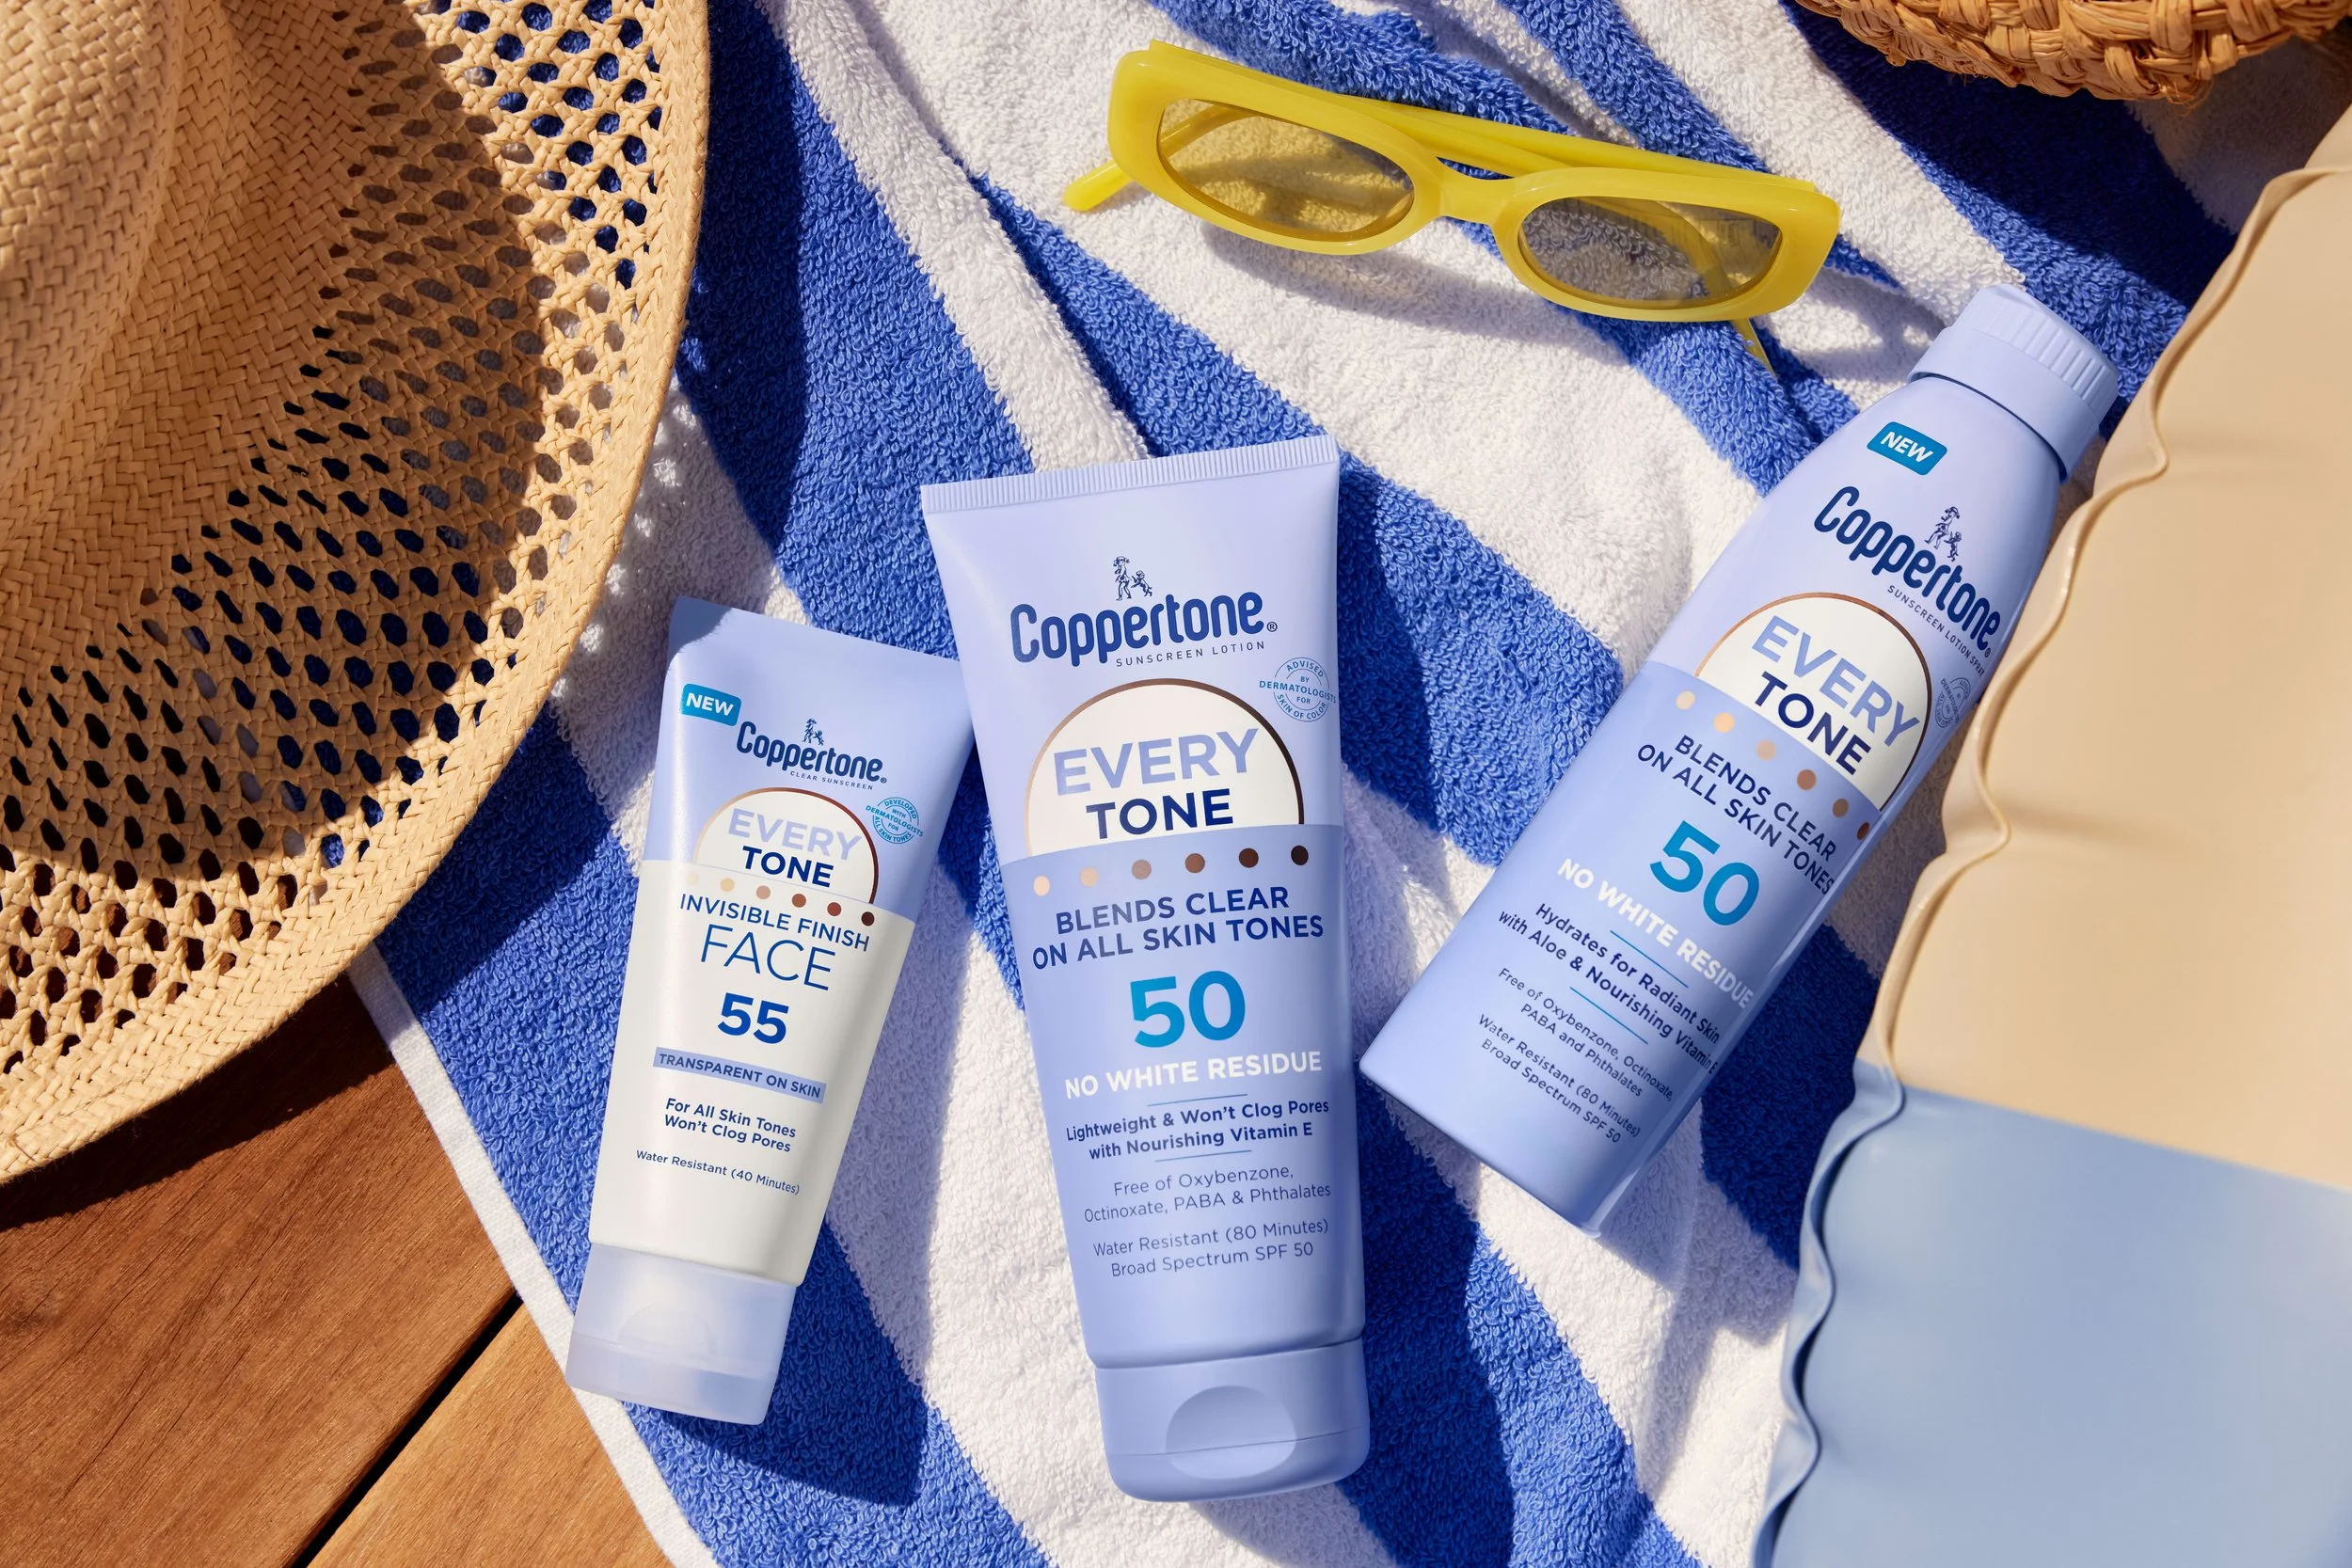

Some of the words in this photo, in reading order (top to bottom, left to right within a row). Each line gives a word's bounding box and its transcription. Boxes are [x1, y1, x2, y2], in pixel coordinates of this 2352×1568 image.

[1881, 431, 1934, 463] NEW
[1887, 585, 1945, 632] SUNSCREEN
[1945, 630, 1970, 658] LOTION
[1969, 656, 1985, 676] SPRAY
[1116, 648, 1203, 667] SUNSCREEN
[1212, 641, 1265, 656] LOTION
[1286, 660, 1324, 677] ADVISED
[1259, 680, 1336, 704] DERMATOLOGISTS
[1296, 696, 1311, 705] FOR
[1752, 615, 1920, 747] EVERY
[686, 693, 734, 717] NEW
[1278, 694, 1293, 713] SKIN
[1294, 710, 1305, 719] OF
[1307, 702, 1327, 720] COLOR
[1754, 671, 1872, 776] TONE
[790, 770, 818, 782] CLEAR
[821, 776, 873, 790] SUNSCREEN
[1054, 728, 1259, 796] EVERY
[866, 805, 924, 837] DERMATOLOGISTS
[884, 799, 917, 819] DEVELOPED
[892, 809, 906, 818] WITH
[1086, 788, 1233, 840] TONE
[1638, 744, 1674, 772] ON
[1673, 767, 1717, 805] ALL
[1724, 799, 1782, 847] SKIN
[1784, 840, 1835, 895] TONES
[1675, 735, 1772, 806] BLENDS
[1773, 802, 1837, 862] CLEAR
[728, 808, 862, 861] EVERY
[879, 828, 892, 840] SKIN
[893, 832, 912, 843] TONES
[887, 823, 899, 832] FOR
[742, 846, 834, 888] TONE
[1649, 820, 1759, 927] 50
[680, 894, 790, 931] INVISIBLE
[797, 917, 870, 952] FINISH
[1056, 896, 1176, 935] BLENDS
[1185, 887, 1290, 916] CLEAR
[1557, 858, 1594, 889] NO
[1597, 880, 1678, 947] WHITE
[1677, 938, 1754, 1009] RESIDUE
[701, 924, 835, 990] FACE
[1032, 942, 1067, 970] ON
[1077, 933, 1134, 962] ALL
[1142, 922, 1216, 951] SKIN
[1226, 915, 1324, 942] TONES
[1499, 911, 1528, 935] with
[1528, 929, 1567, 960] Aloe
[1570, 956, 1584, 972] &
[1585, 965, 1673, 1038] Nourishing
[1676, 1029, 1713, 1070] Vitamin
[1708, 1061, 1719, 1074] E
[1535, 903, 1609, 958] Hydrates
[1610, 953, 1638, 977] for
[1638, 973, 1697, 1024] Radiant
[1696, 1018, 1720, 1044] Skin
[717, 992, 789, 1044] 55
[1129, 970, 1246, 1048] 50
[1498, 968, 1525, 990] Free
[1527, 989, 1543, 1001] of
[1543, 998, 1619, 1060] Oxybenzone,
[1520, 1004, 1557, 1034] PABA
[1559, 1032, 1585, 1053] and
[1585, 1049, 1643, 1097] Phthalates
[659, 1053, 763, 1084] TRANSPARENT
[766, 1075, 788, 1089] ON
[790, 1082, 821, 1099] SKIN
[1065, 1074, 1099, 1099] NO
[1105, 1060, 1199, 1090] WHITE
[1207, 1051, 1322, 1080] RESIDUE
[1479, 1014, 1516, 1045] Water
[1516, 1041, 1576, 1088] Resistant
[1576, 1085, 1598, 1104] (80
[1599, 1101, 1642, 1138] Minutes)
[1481, 1038, 1522, 1070] Broad
[1521, 1068, 1581, 1116] Spectrum
[1582, 1111, 1608, 1131] SPF
[1606, 1130, 1621, 1143] 50
[665, 1098, 690, 1113] For
[693, 1103, 715, 1118] All
[719, 1109, 751, 1126] Skin
[756, 1117, 797, 1138] Tones
[712, 1124, 747, 1143] Clog
[752, 1133, 791, 1152] Pores
[1066, 1115, 1156, 1142] Lightweight
[1162, 1113, 1175, 1127] &
[1242, 1101, 1283, 1121] Clog
[1288, 1099, 1329, 1115] Pores
[1089, 1143, 1121, 1160] with
[1127, 1129, 1224, 1155] Nourishing
[1230, 1122, 1299, 1142] Vitamin
[1303, 1122, 1313, 1136] E
[636, 1149, 668, 1164] Water
[672, 1156, 727, 1176] Resistant
[731, 1168, 753, 1181] (40
[756, 1172, 800, 1195] Minutes)
[1114, 1178, 1150, 1196] Free
[1154, 1175, 1172, 1192] of
[1179, 1164, 1295, 1190] Oxybenzone,
[1084, 1198, 1168, 1223] Octinoxate,
[1174, 1193, 1227, 1211] PABA
[1232, 1190, 1245, 1205] &
[1249, 1182, 1331, 1202] Phthalates
[1093, 1239, 1134, 1257] Water
[1138, 1230, 1220, 1252] Resistant
[1226, 1225, 1257, 1244] (80
[1263, 1218, 1329, 1238] Minutes)
[1111, 1259, 1157, 1276] Broad
[1162, 1249, 1249, 1273] Spectrum
[1255, 1243, 1289, 1261] SPF
[1294, 1242, 1314, 1258] 50
